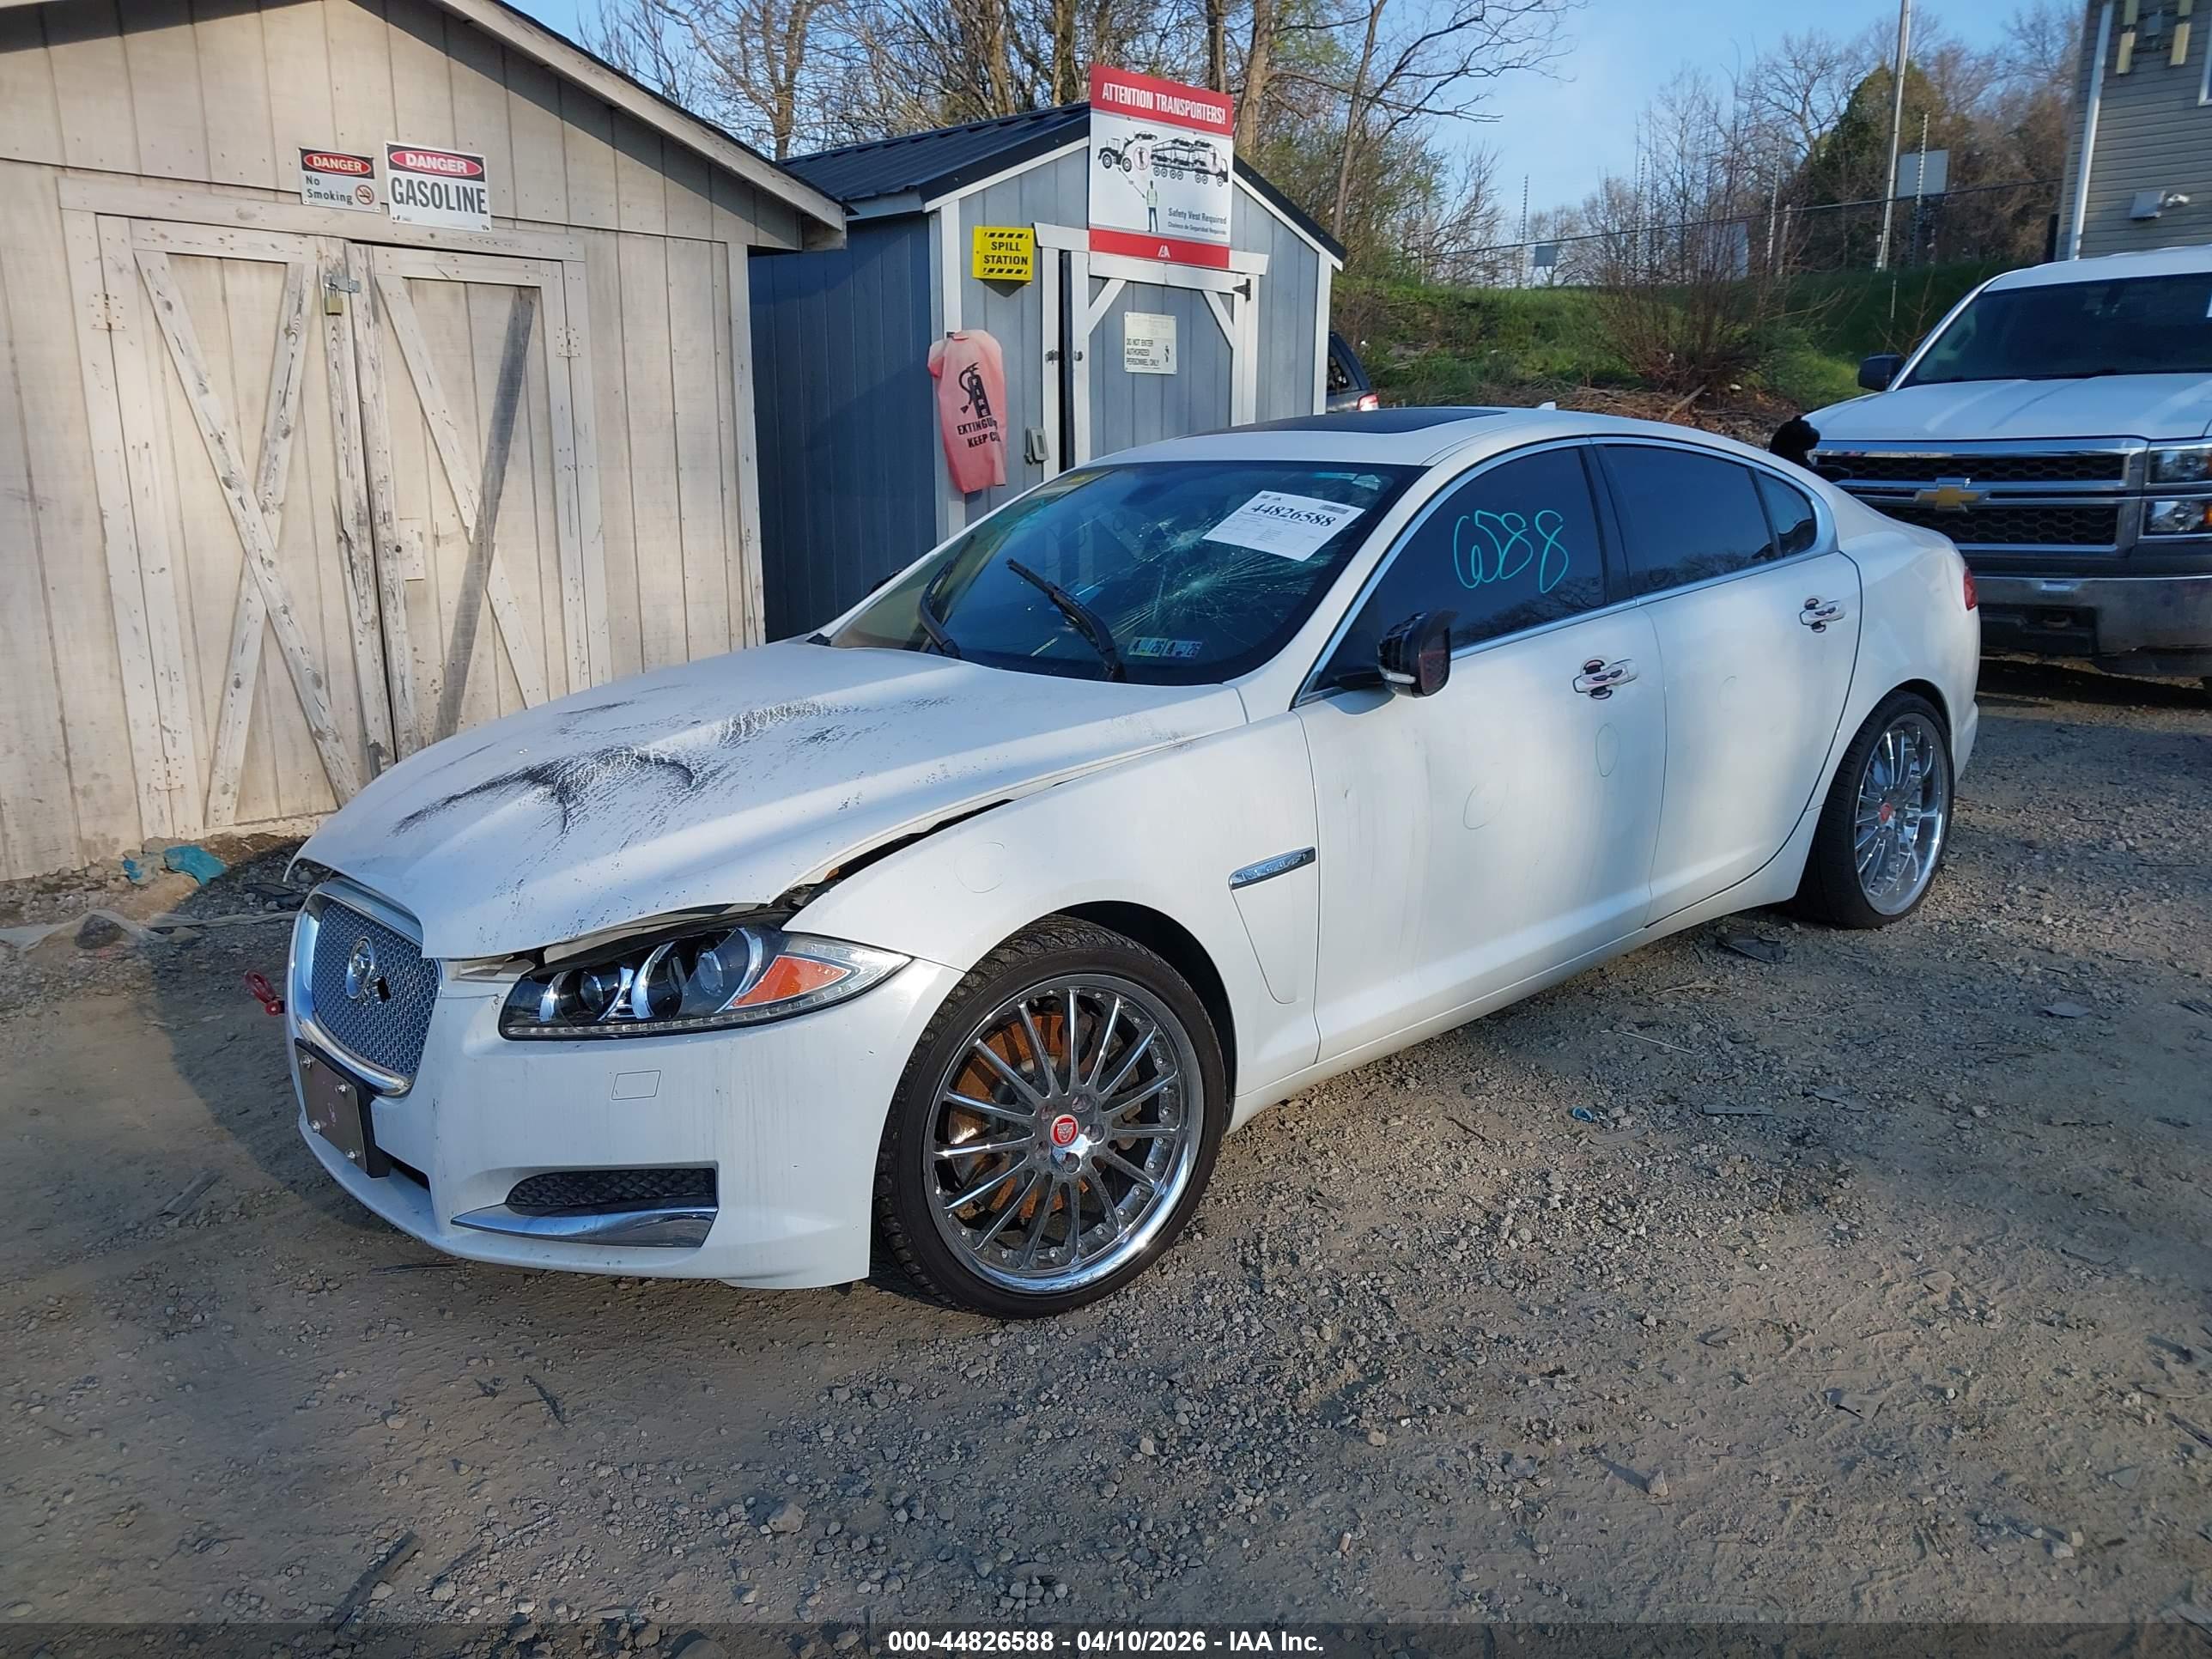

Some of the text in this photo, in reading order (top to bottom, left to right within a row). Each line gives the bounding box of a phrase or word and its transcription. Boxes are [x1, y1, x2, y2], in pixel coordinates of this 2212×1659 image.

[1102, 82, 1227, 125] ATTENTION TRANSPORTERS!
[313, 155, 362, 173] DANGER
[405, 153, 469, 173] DANGER
[306, 175, 320, 187] No
[307, 188, 354, 205] Smoking
[391, 177, 489, 215] GASOLINE
[1168, 207, 1187, 221] Safety
[1188, 210, 1201, 221] Vest
[991, 241, 1022, 252] SPILL
[983, 254, 1029, 265] STATION
[972, 377, 989, 417] FIRE
[967, 434, 988, 448] KEEP
[1250, 502, 1337, 527] 44826588
